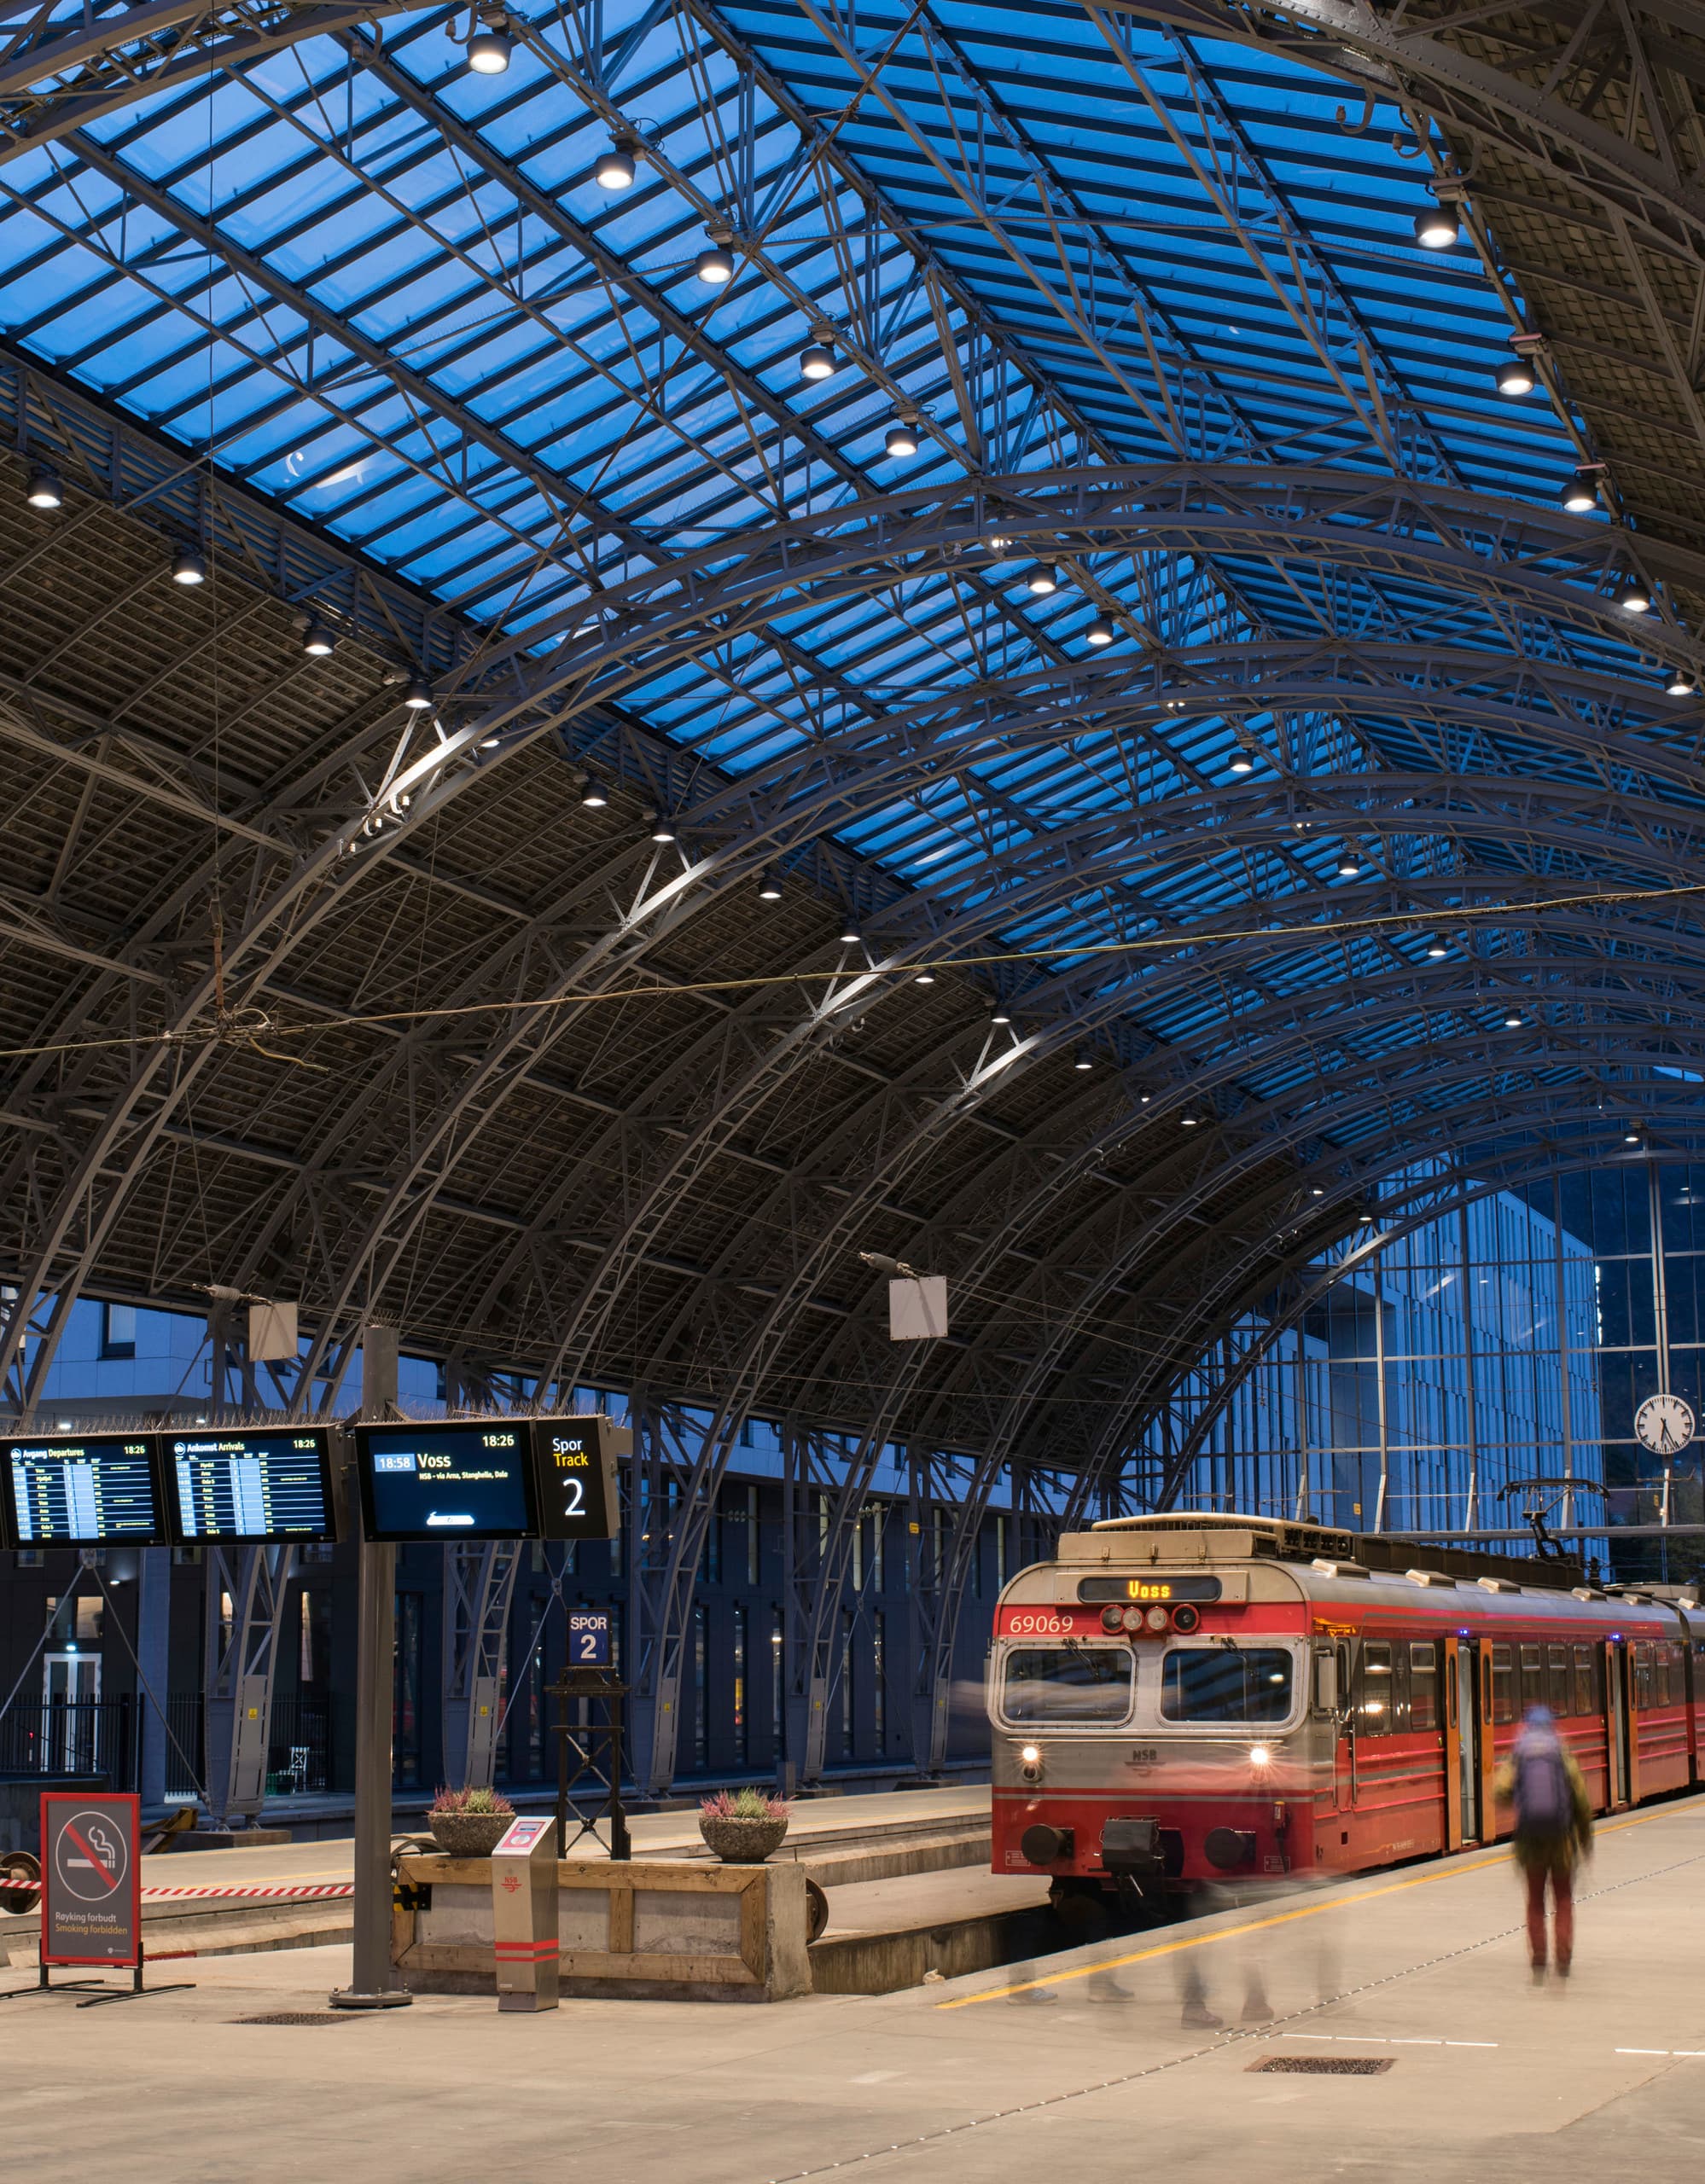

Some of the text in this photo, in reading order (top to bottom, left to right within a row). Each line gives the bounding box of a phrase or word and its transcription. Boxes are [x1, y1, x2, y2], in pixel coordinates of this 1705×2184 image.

[218, 1442, 245, 1451] Arrivals
[293, 1440, 316, 1449] 18:26
[482, 1434, 515, 1447] 18:26
[552, 1438, 583, 1454] Spor
[23, 1449, 84, 1459] Avgang Departures
[124, 1445, 145, 1455] 18:26
[380, 1456, 411, 1468] 18:58
[416, 1453, 451, 1468] Voss
[553, 1452, 589, 1467] Track
[562, 1478, 586, 1516] 2
[1129, 1580, 1170, 1598] Voss
[570, 1617, 607, 1629] SPOR
[1010, 1616, 1074, 1633] 69069
[580, 1634, 596, 1659] 2
[1132, 1749, 1157, 1761] NSB
[55, 1912, 116, 1923] Røyking forbudt
[55, 1923, 127, 1935] Smoking forbidden
